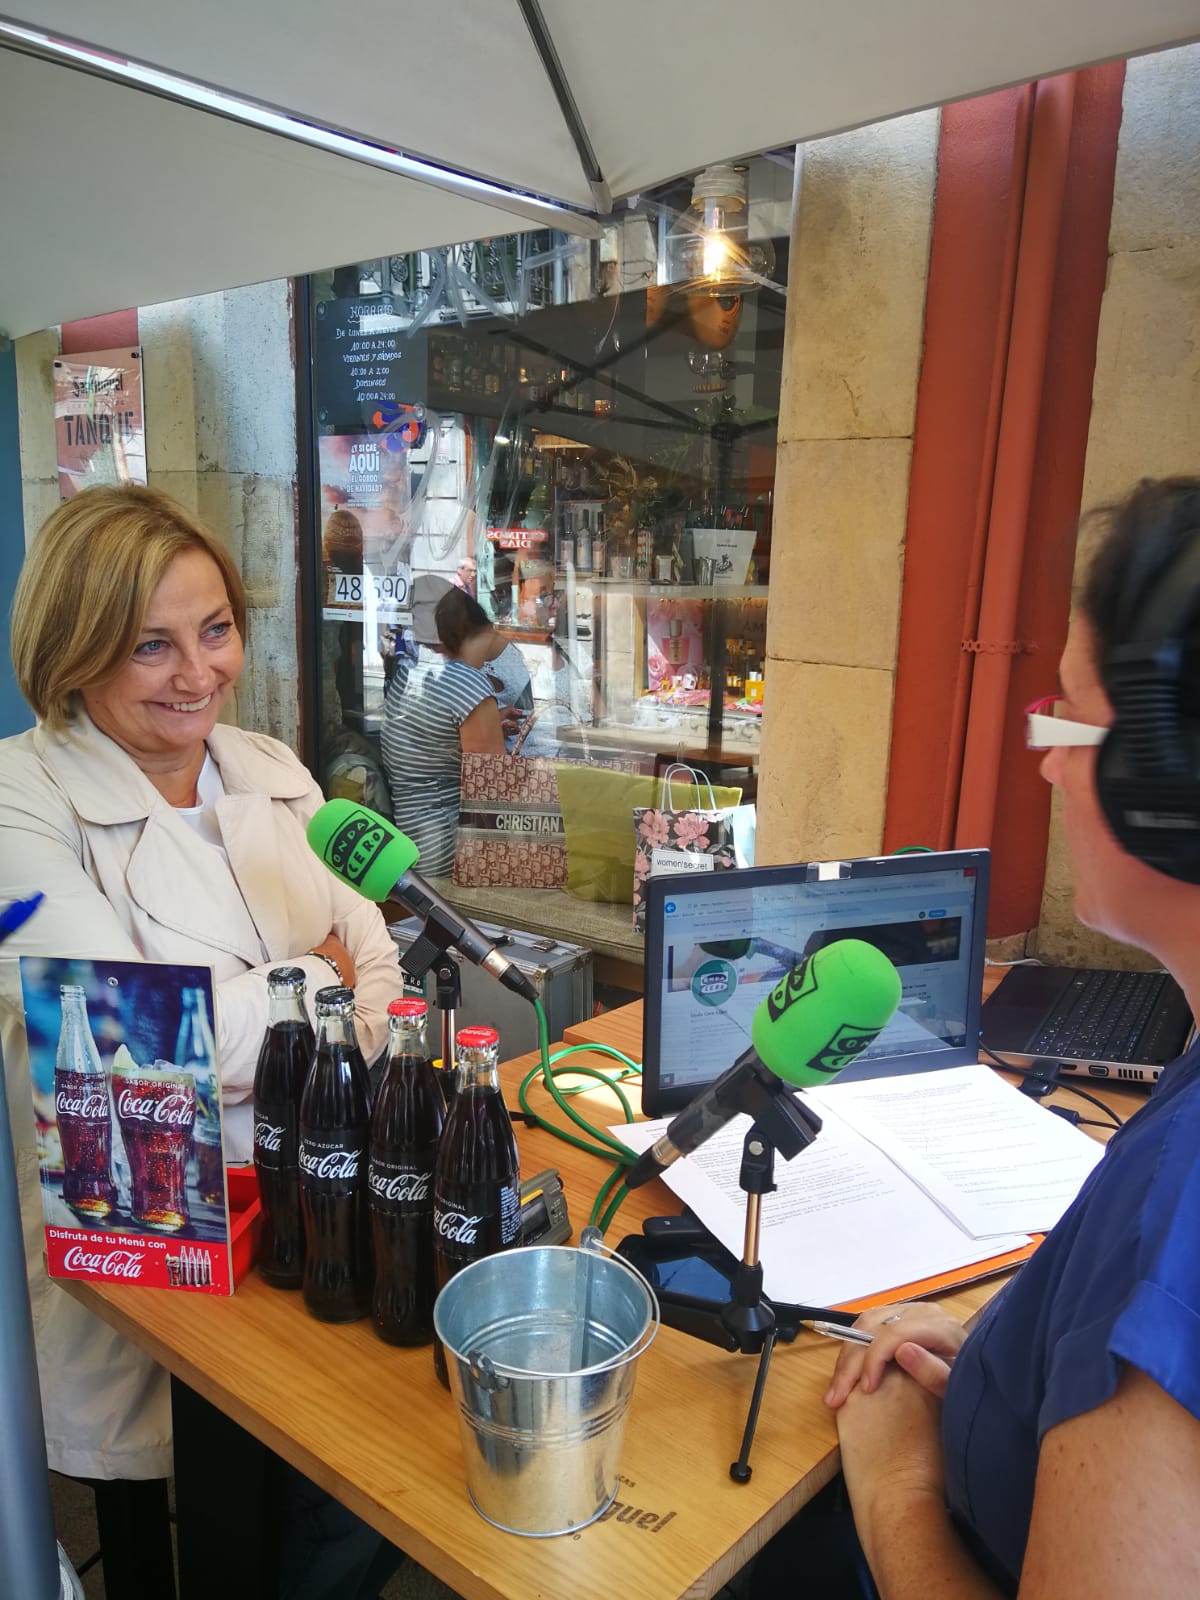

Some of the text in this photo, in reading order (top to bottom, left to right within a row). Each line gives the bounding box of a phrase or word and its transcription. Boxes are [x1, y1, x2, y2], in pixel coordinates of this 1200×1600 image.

[348, 451, 380, 474] AQUÍ
[496, 814, 560, 833] CHRISTIAN
[332, 822, 366, 862] ONDA
[348, 832, 381, 873] CERO
[56, 1091, 109, 1119] Coca-Cola
[118, 1089, 194, 1125] Coca-Cola
[298, 1144, 363, 1180] Coca-Cola
[49, 1229, 167, 1250] Disfruta de tu Menú con
[63, 1245, 146, 1279] Coca-Cola
